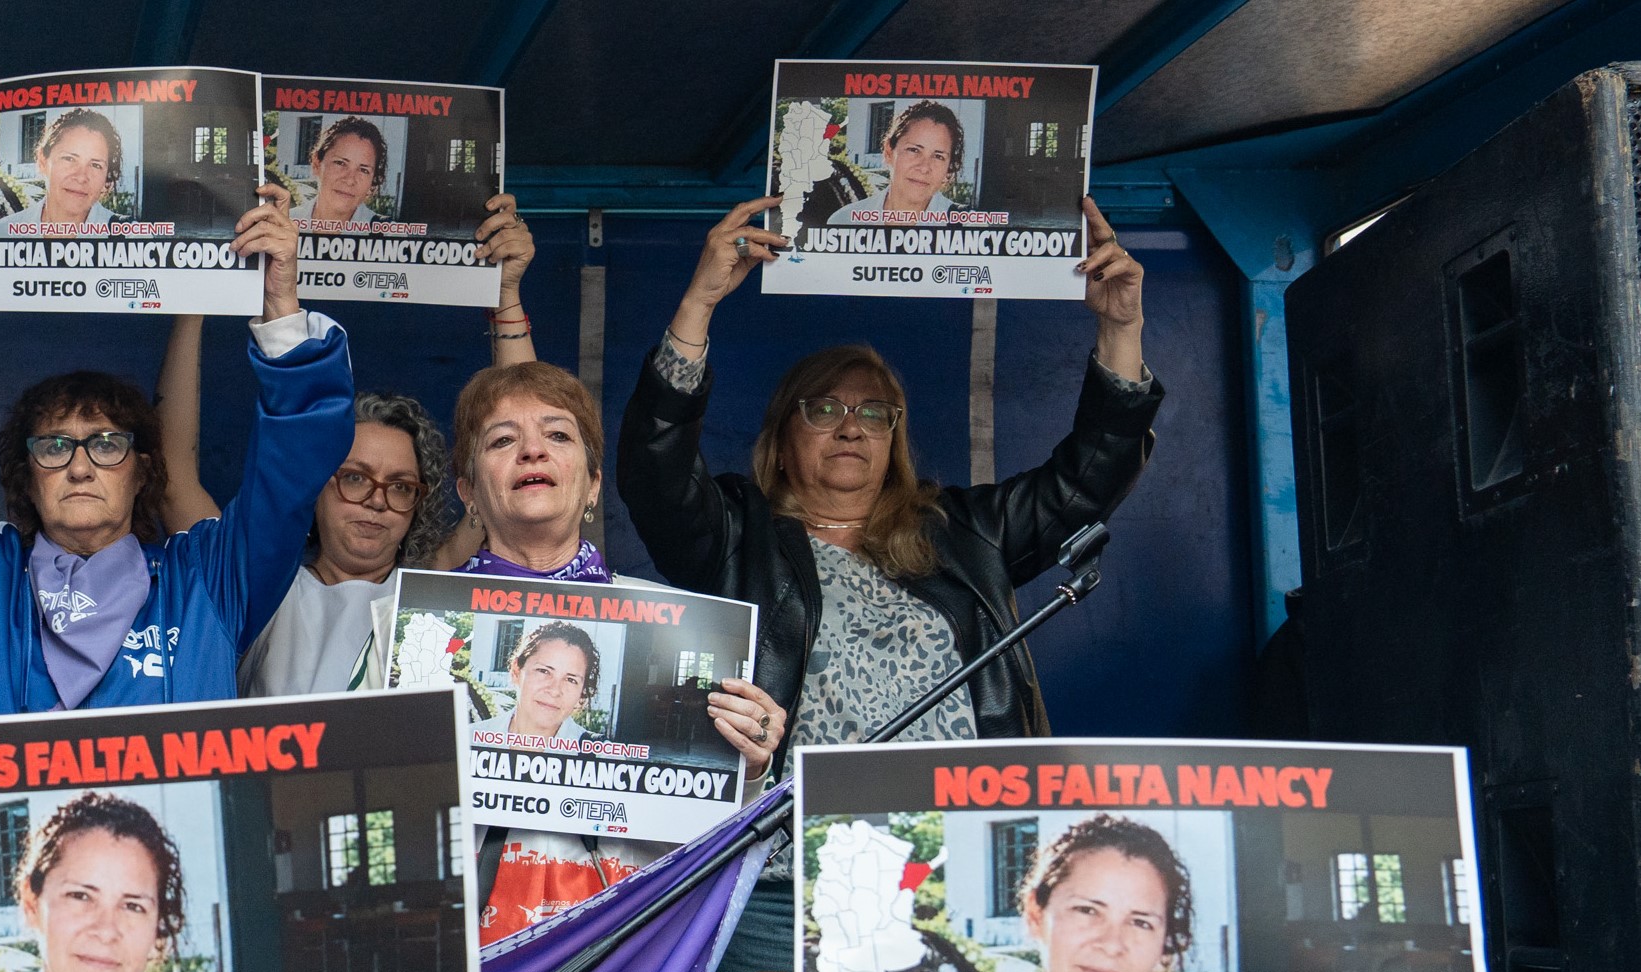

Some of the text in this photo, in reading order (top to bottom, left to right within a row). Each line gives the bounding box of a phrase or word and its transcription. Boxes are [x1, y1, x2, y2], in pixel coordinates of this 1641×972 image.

[47, 81, 113, 105] FALTA
[117, 80, 197, 103] NANCY
[845, 74, 1035, 98] NOS FALTA NANCY
[275, 88, 453, 116] NOS FALTA NANCY
[9, 222, 174, 235] NOS FALTA UNA DOCENTE
[310, 220, 343, 231] FALTA
[345, 222, 369, 232] UNA
[372, 222, 427, 234] DOCENTE
[851, 211, 1008, 223] NOS FALTA UNA DOCENTE
[50, 242, 94, 268] POR
[97, 242, 170, 268] NANCY
[317, 236, 356, 260] POR
[358, 239, 423, 262] NANCY
[804, 228, 1076, 256] JUSTICIA POR NANCY GODOY
[297, 272, 408, 289] UTECO CTERA
[852, 266, 992, 284] SUTECO CTERA
[13, 279, 160, 299] SUTECO CTERA
[471, 588, 686, 626] NOS FALTA NANCY
[25, 734, 157, 786] FALTA
[160, 723, 326, 775] NANCY
[473, 730, 649, 758] NOS FALTA UNA DOCENTE
[471, 750, 729, 800] ICIA POR NANCY GODOY
[933, 766, 1333, 807] NOS FALTA NANCY
[472, 792, 628, 823] SUTECO CTERA
